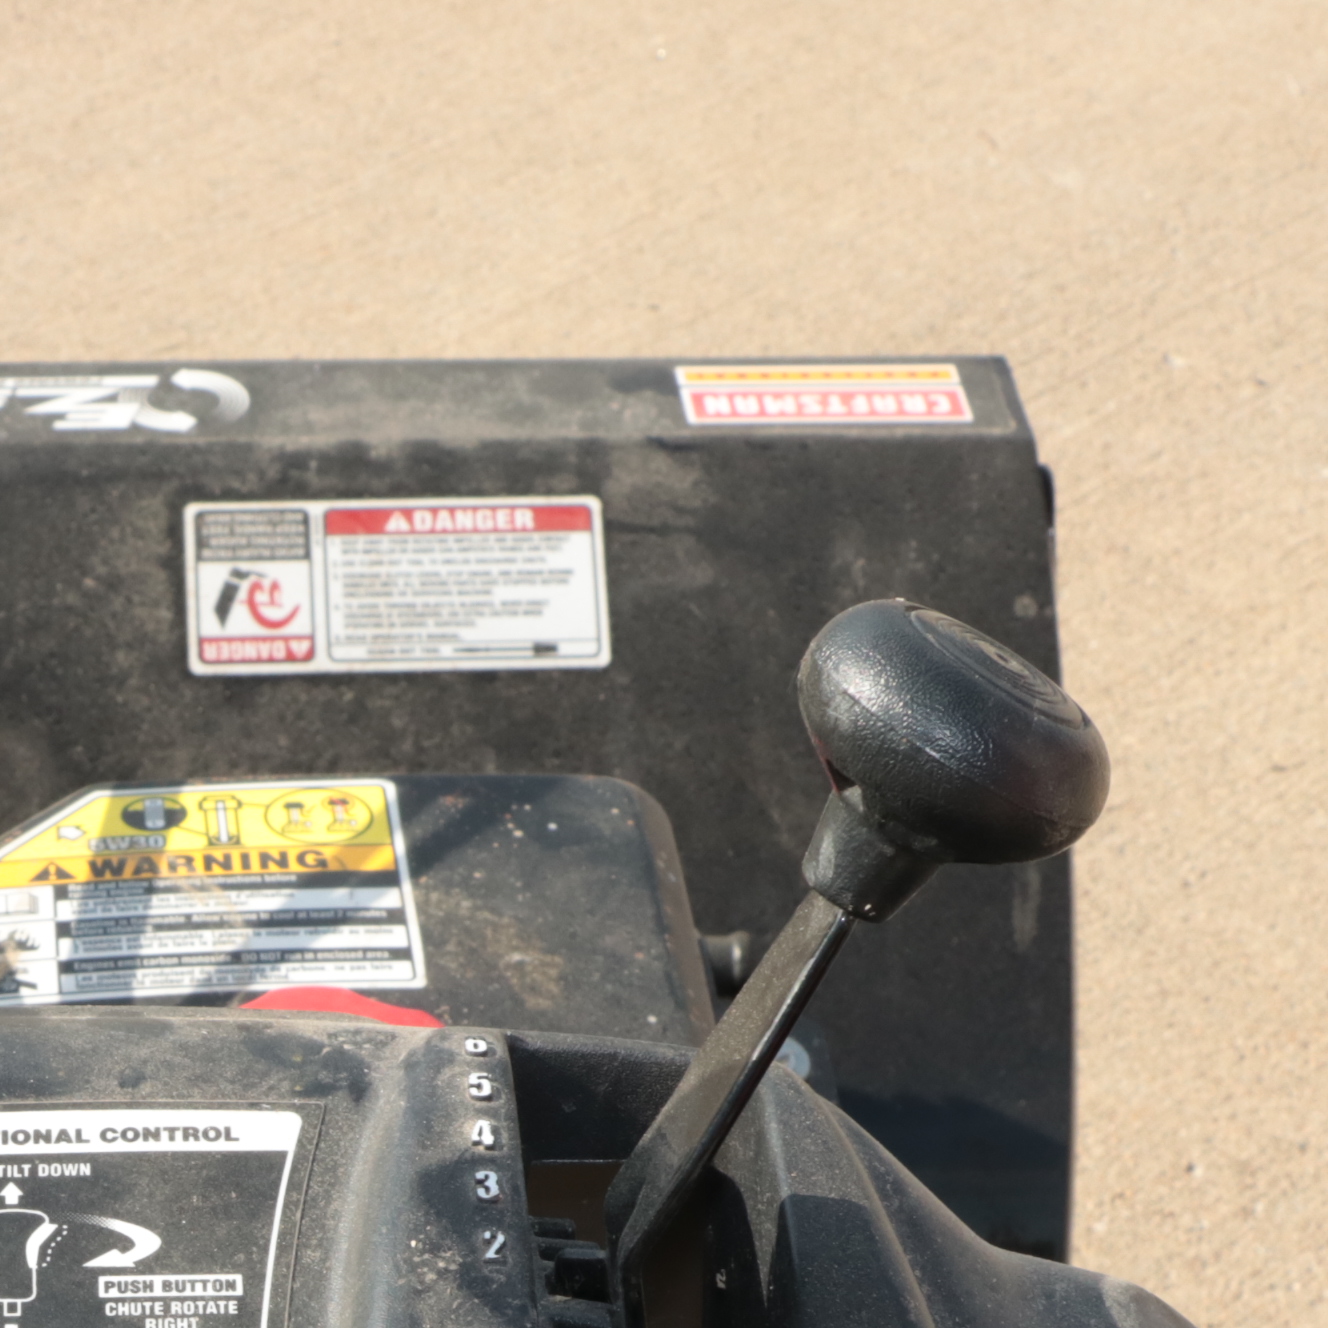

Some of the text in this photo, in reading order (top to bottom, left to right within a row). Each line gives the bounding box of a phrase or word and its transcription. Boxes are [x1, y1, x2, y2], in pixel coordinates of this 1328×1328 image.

[703, 393, 952, 416] CRAFTSMAN
[412, 508, 534, 531] DANGER
[202, 640, 286, 661] DANGER
[88, 851, 330, 879] WARNING
[468, 1072, 492, 1097] 5
[100, 1127, 239, 1143] CONTROL
[472, 1120, 494, 1145] 4
[38, 1163, 90, 1177] DOWN
[475, 1171, 500, 1198] 3
[483, 1230, 505, 1258] 2
[104, 1279, 236, 1294] PUSH BUTTON
[105, 1301, 238, 1316] CHUTE ROTATE
